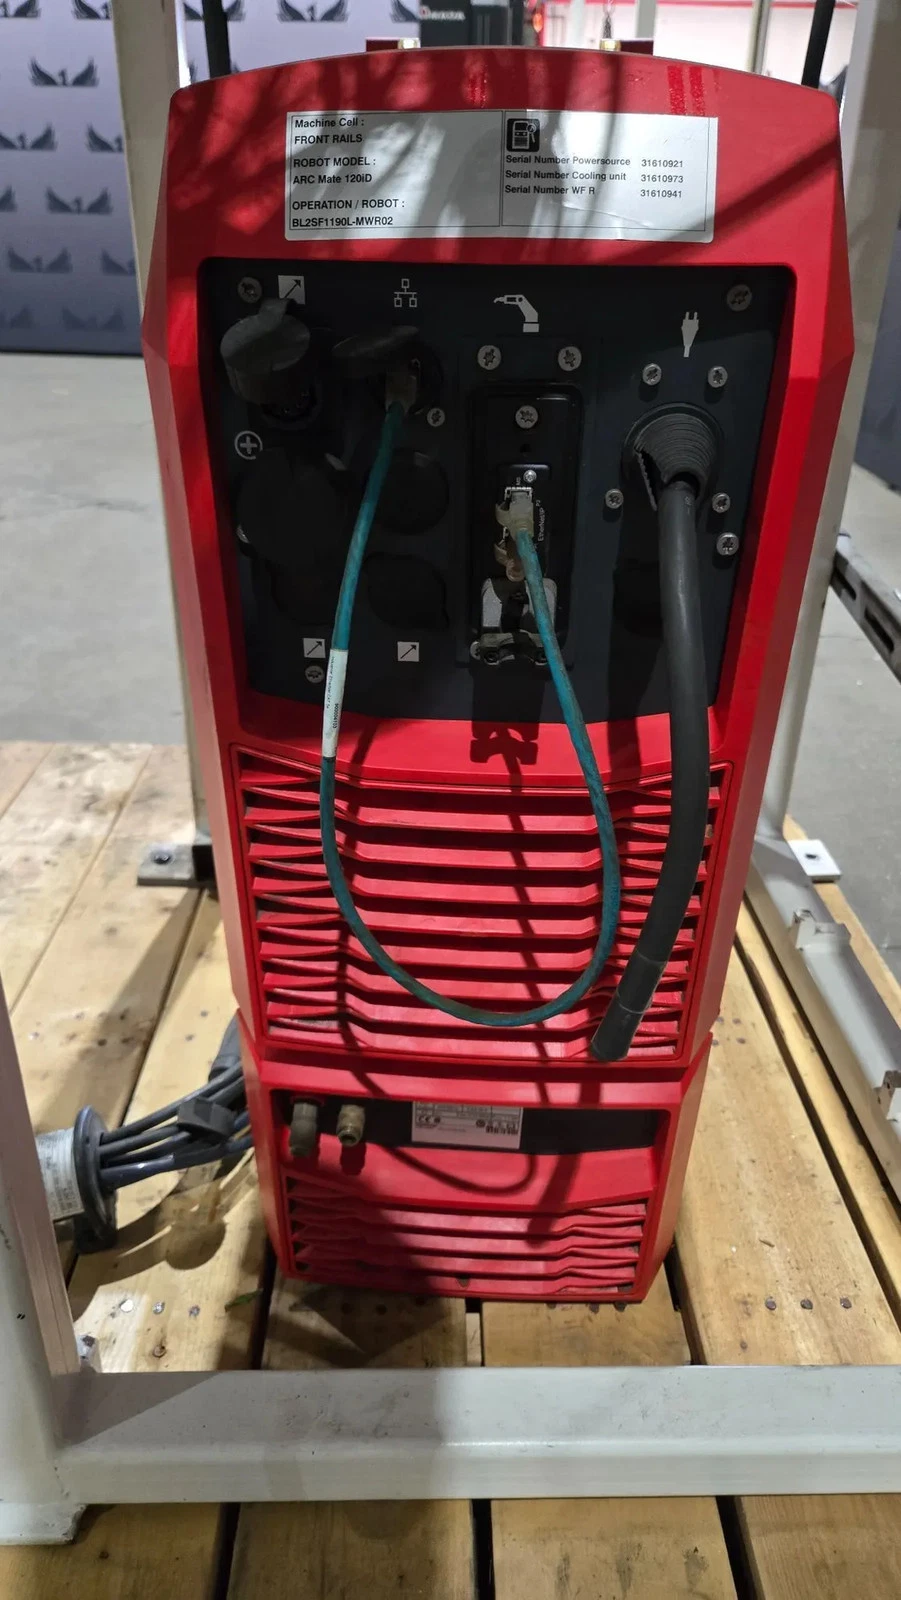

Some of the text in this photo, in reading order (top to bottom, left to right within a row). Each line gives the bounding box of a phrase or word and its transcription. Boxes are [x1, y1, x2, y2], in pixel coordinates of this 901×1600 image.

[294, 119, 336, 128] Machine
[339, 118, 358, 127] Cell
[294, 134, 363, 145] FRONT RAILS
[293, 158, 331, 168] ROBOT
[333, 157, 371, 166] MODEL
[506, 155, 683, 168] Serial Number Powersource 31610921
[293, 174, 373, 184] ARC Mate 120iD
[505, 170, 684, 183] Serial Number Cooling unit 31610973
[504, 185, 531, 194] Serial
[533, 186, 569, 194] Number
[572, 186, 586, 194] WF
[640, 189, 682, 198] 31610941
[292, 200, 352, 211] OPERATION
[361, 199, 398, 209] ROBOT
[292, 217, 394, 227] BL2SF1190L-MWR02
